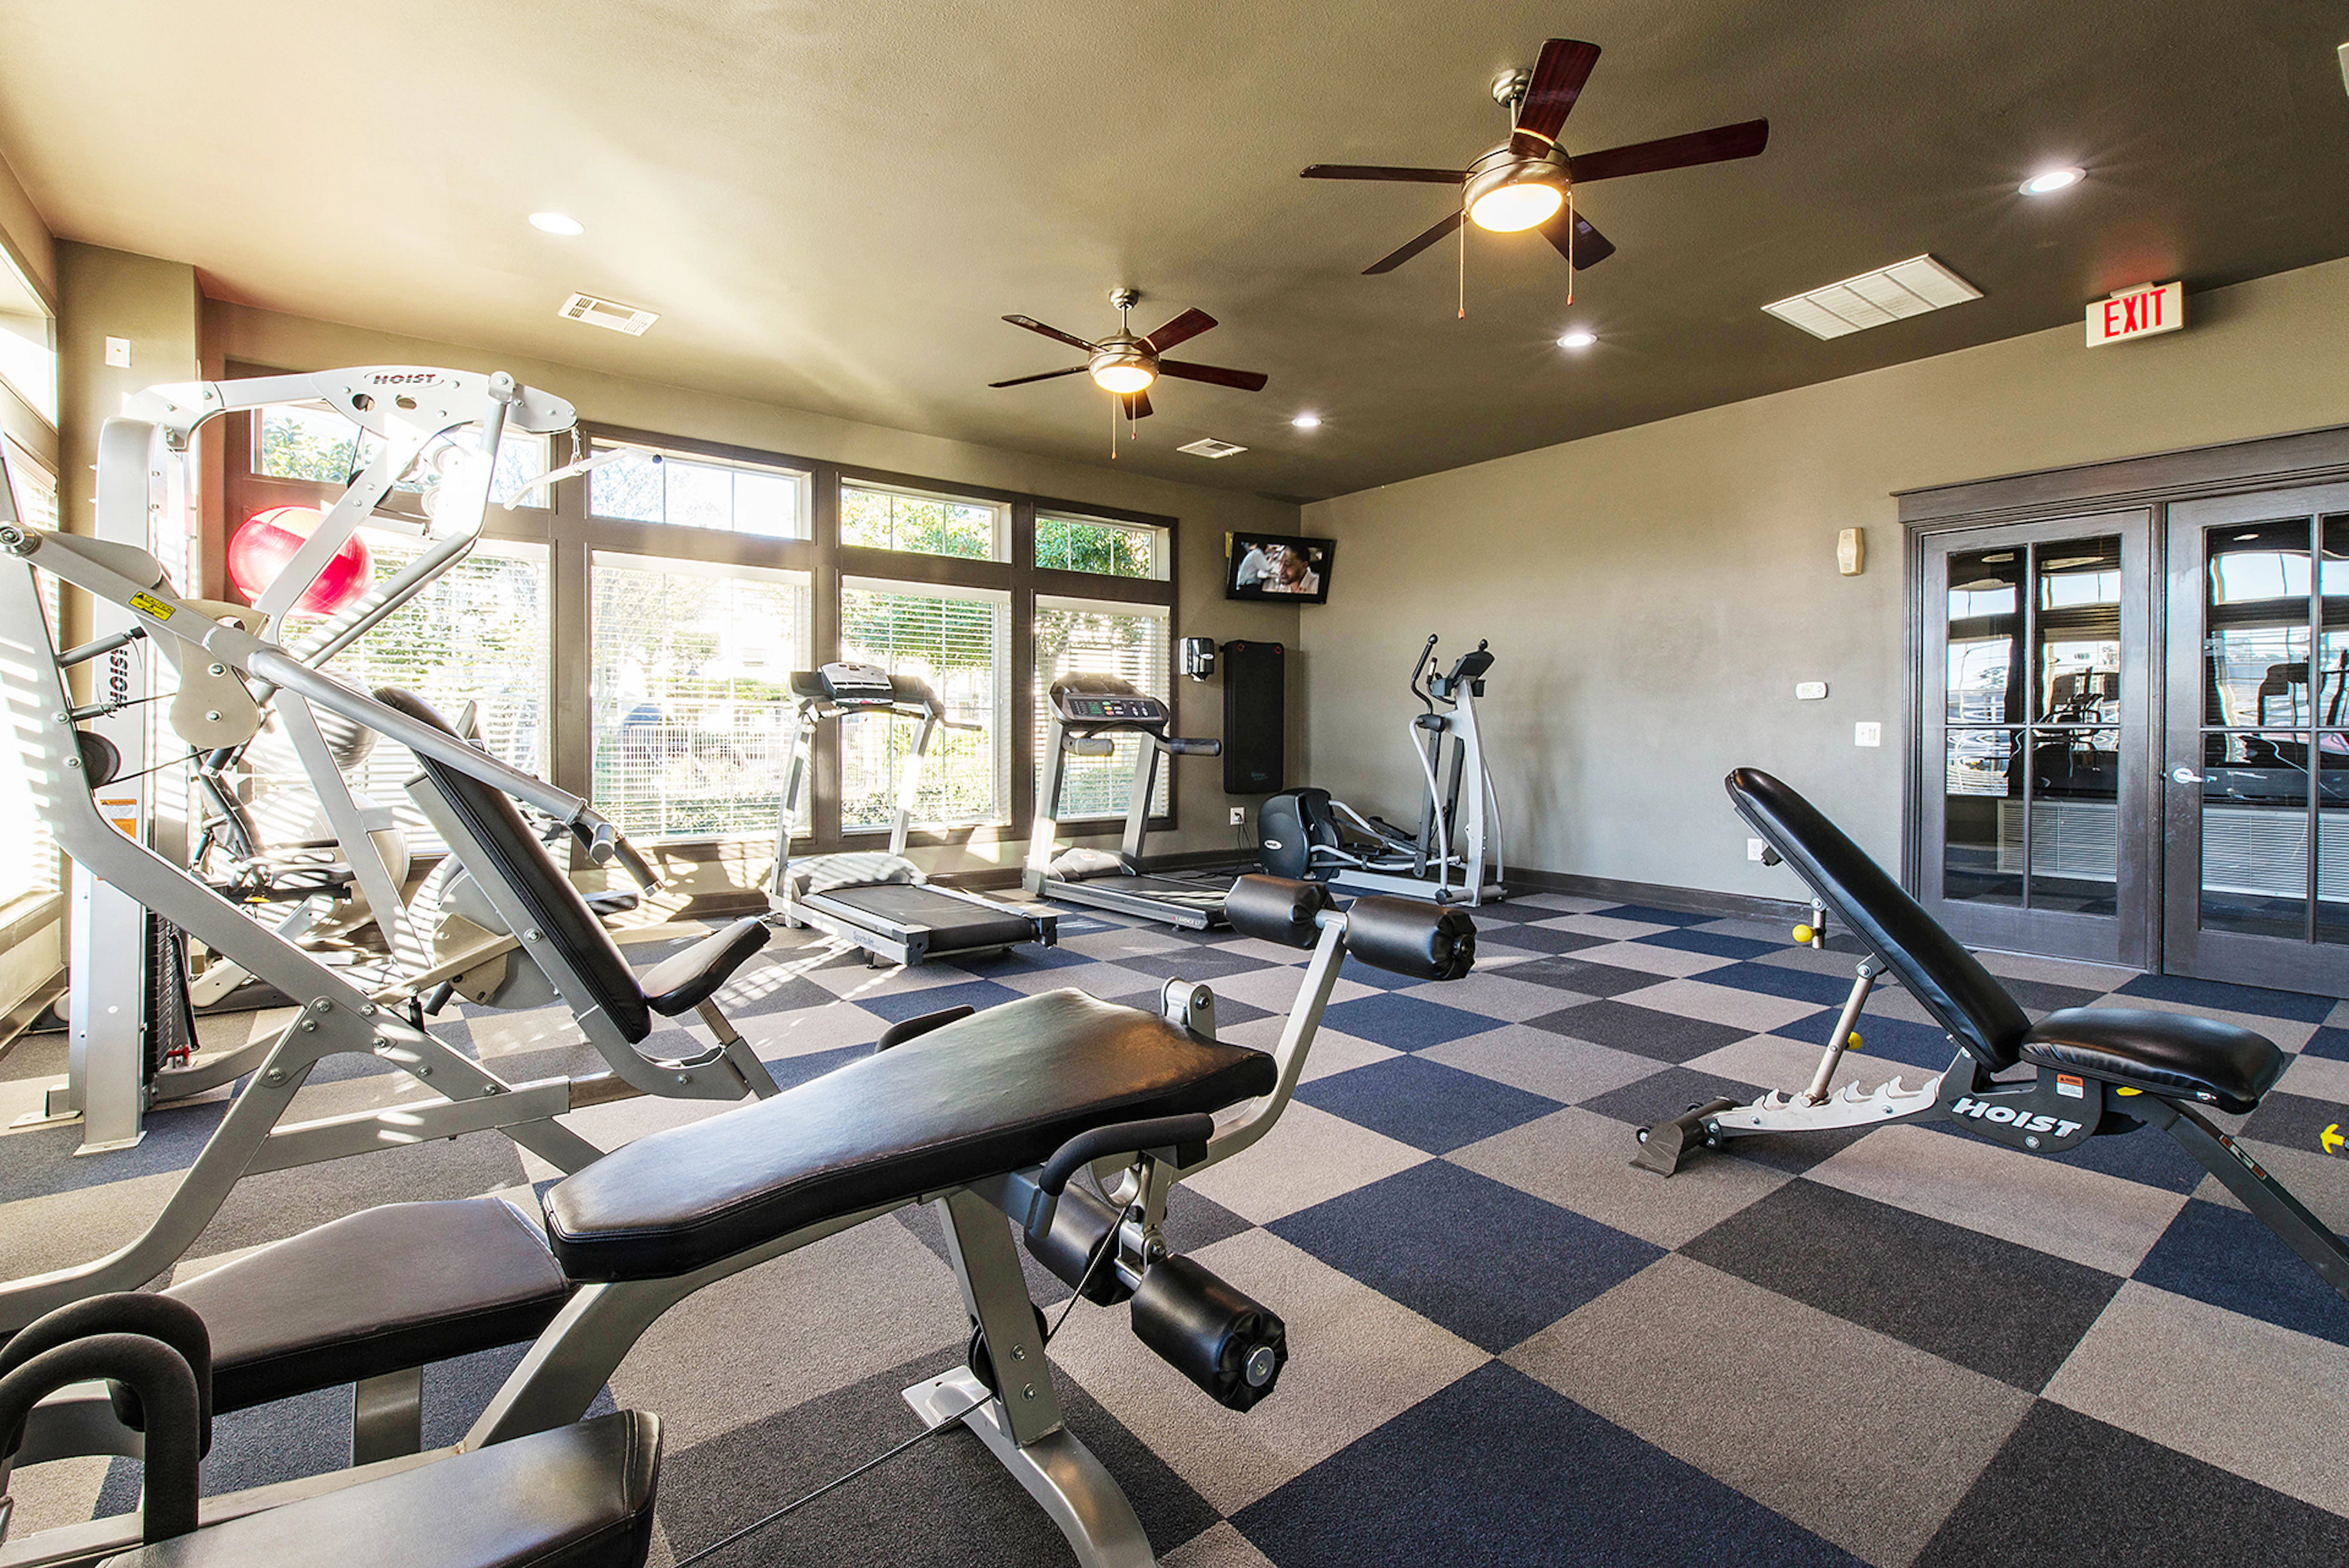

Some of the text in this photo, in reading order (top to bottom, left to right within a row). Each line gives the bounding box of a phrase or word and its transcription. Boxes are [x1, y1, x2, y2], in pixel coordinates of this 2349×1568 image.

[2104, 288, 2167, 338] EXIT
[373, 374, 436, 385] HOIST
[1952, 1097, 2083, 1138] HOIST
